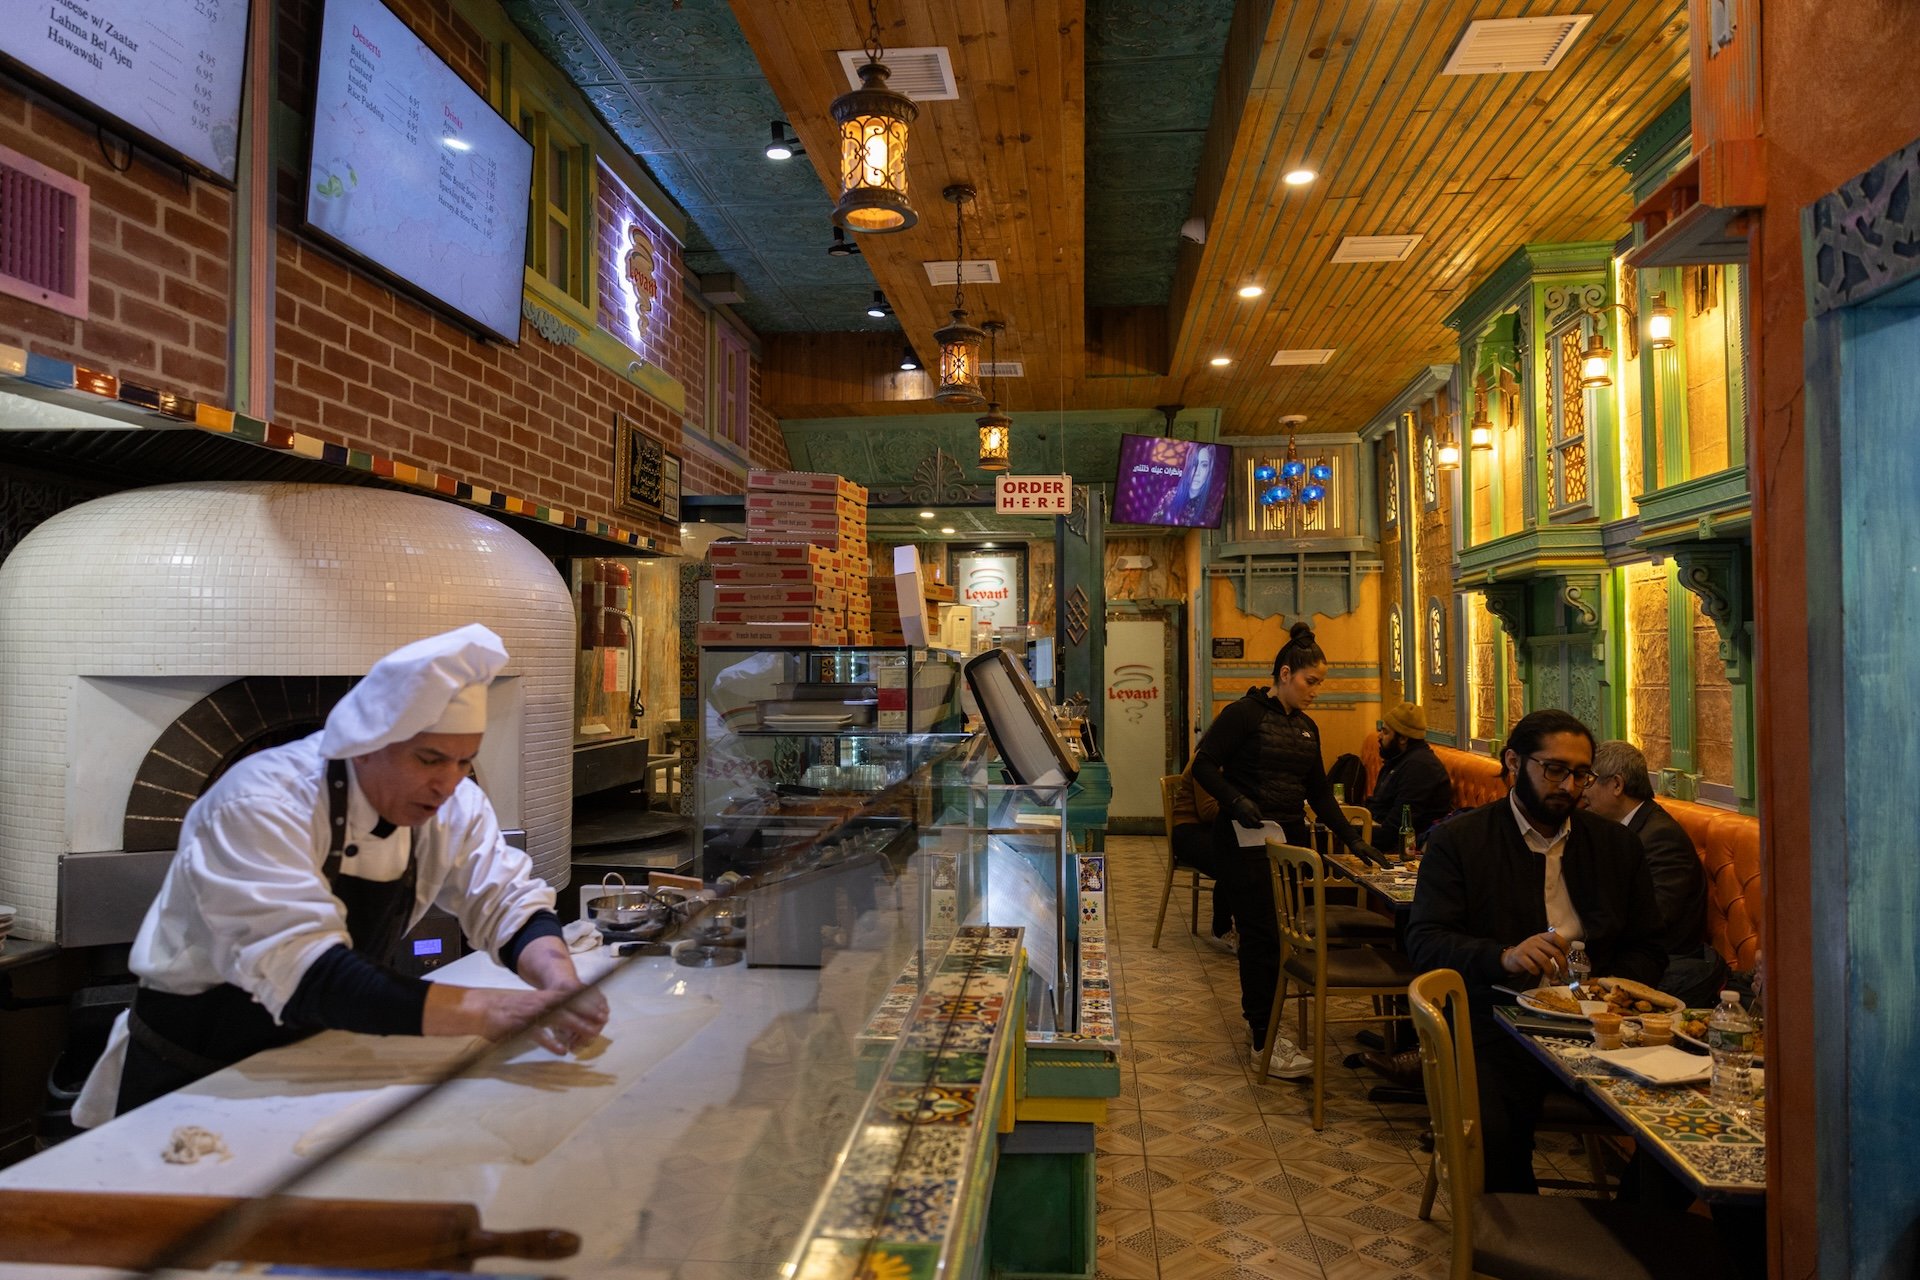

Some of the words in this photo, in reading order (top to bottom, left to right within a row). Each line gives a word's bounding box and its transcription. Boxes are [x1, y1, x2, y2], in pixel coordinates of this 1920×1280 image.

[48, 26, 103, 70] Hawawshi
[352, 24, 381, 58] Desserts
[50, 6, 88, 40] Lahma
[90, 32, 107, 53] Bel
[109, 46, 133, 69] Ajen
[193, 99, 210, 117] 6.95
[105, 22, 139, 52] Zaatar
[194, 83, 212, 101] 6.95
[349, 58, 372, 83] Custard
[361, 95, 385, 122] Pudding
[444, 105, 463, 130] Drinks
[629, 257, 658, 299] Levant
[1003, 481, 1065, 494] ORDER
[965, 587, 1009, 600] Levant
[1108, 686, 1159, 700] Levant
